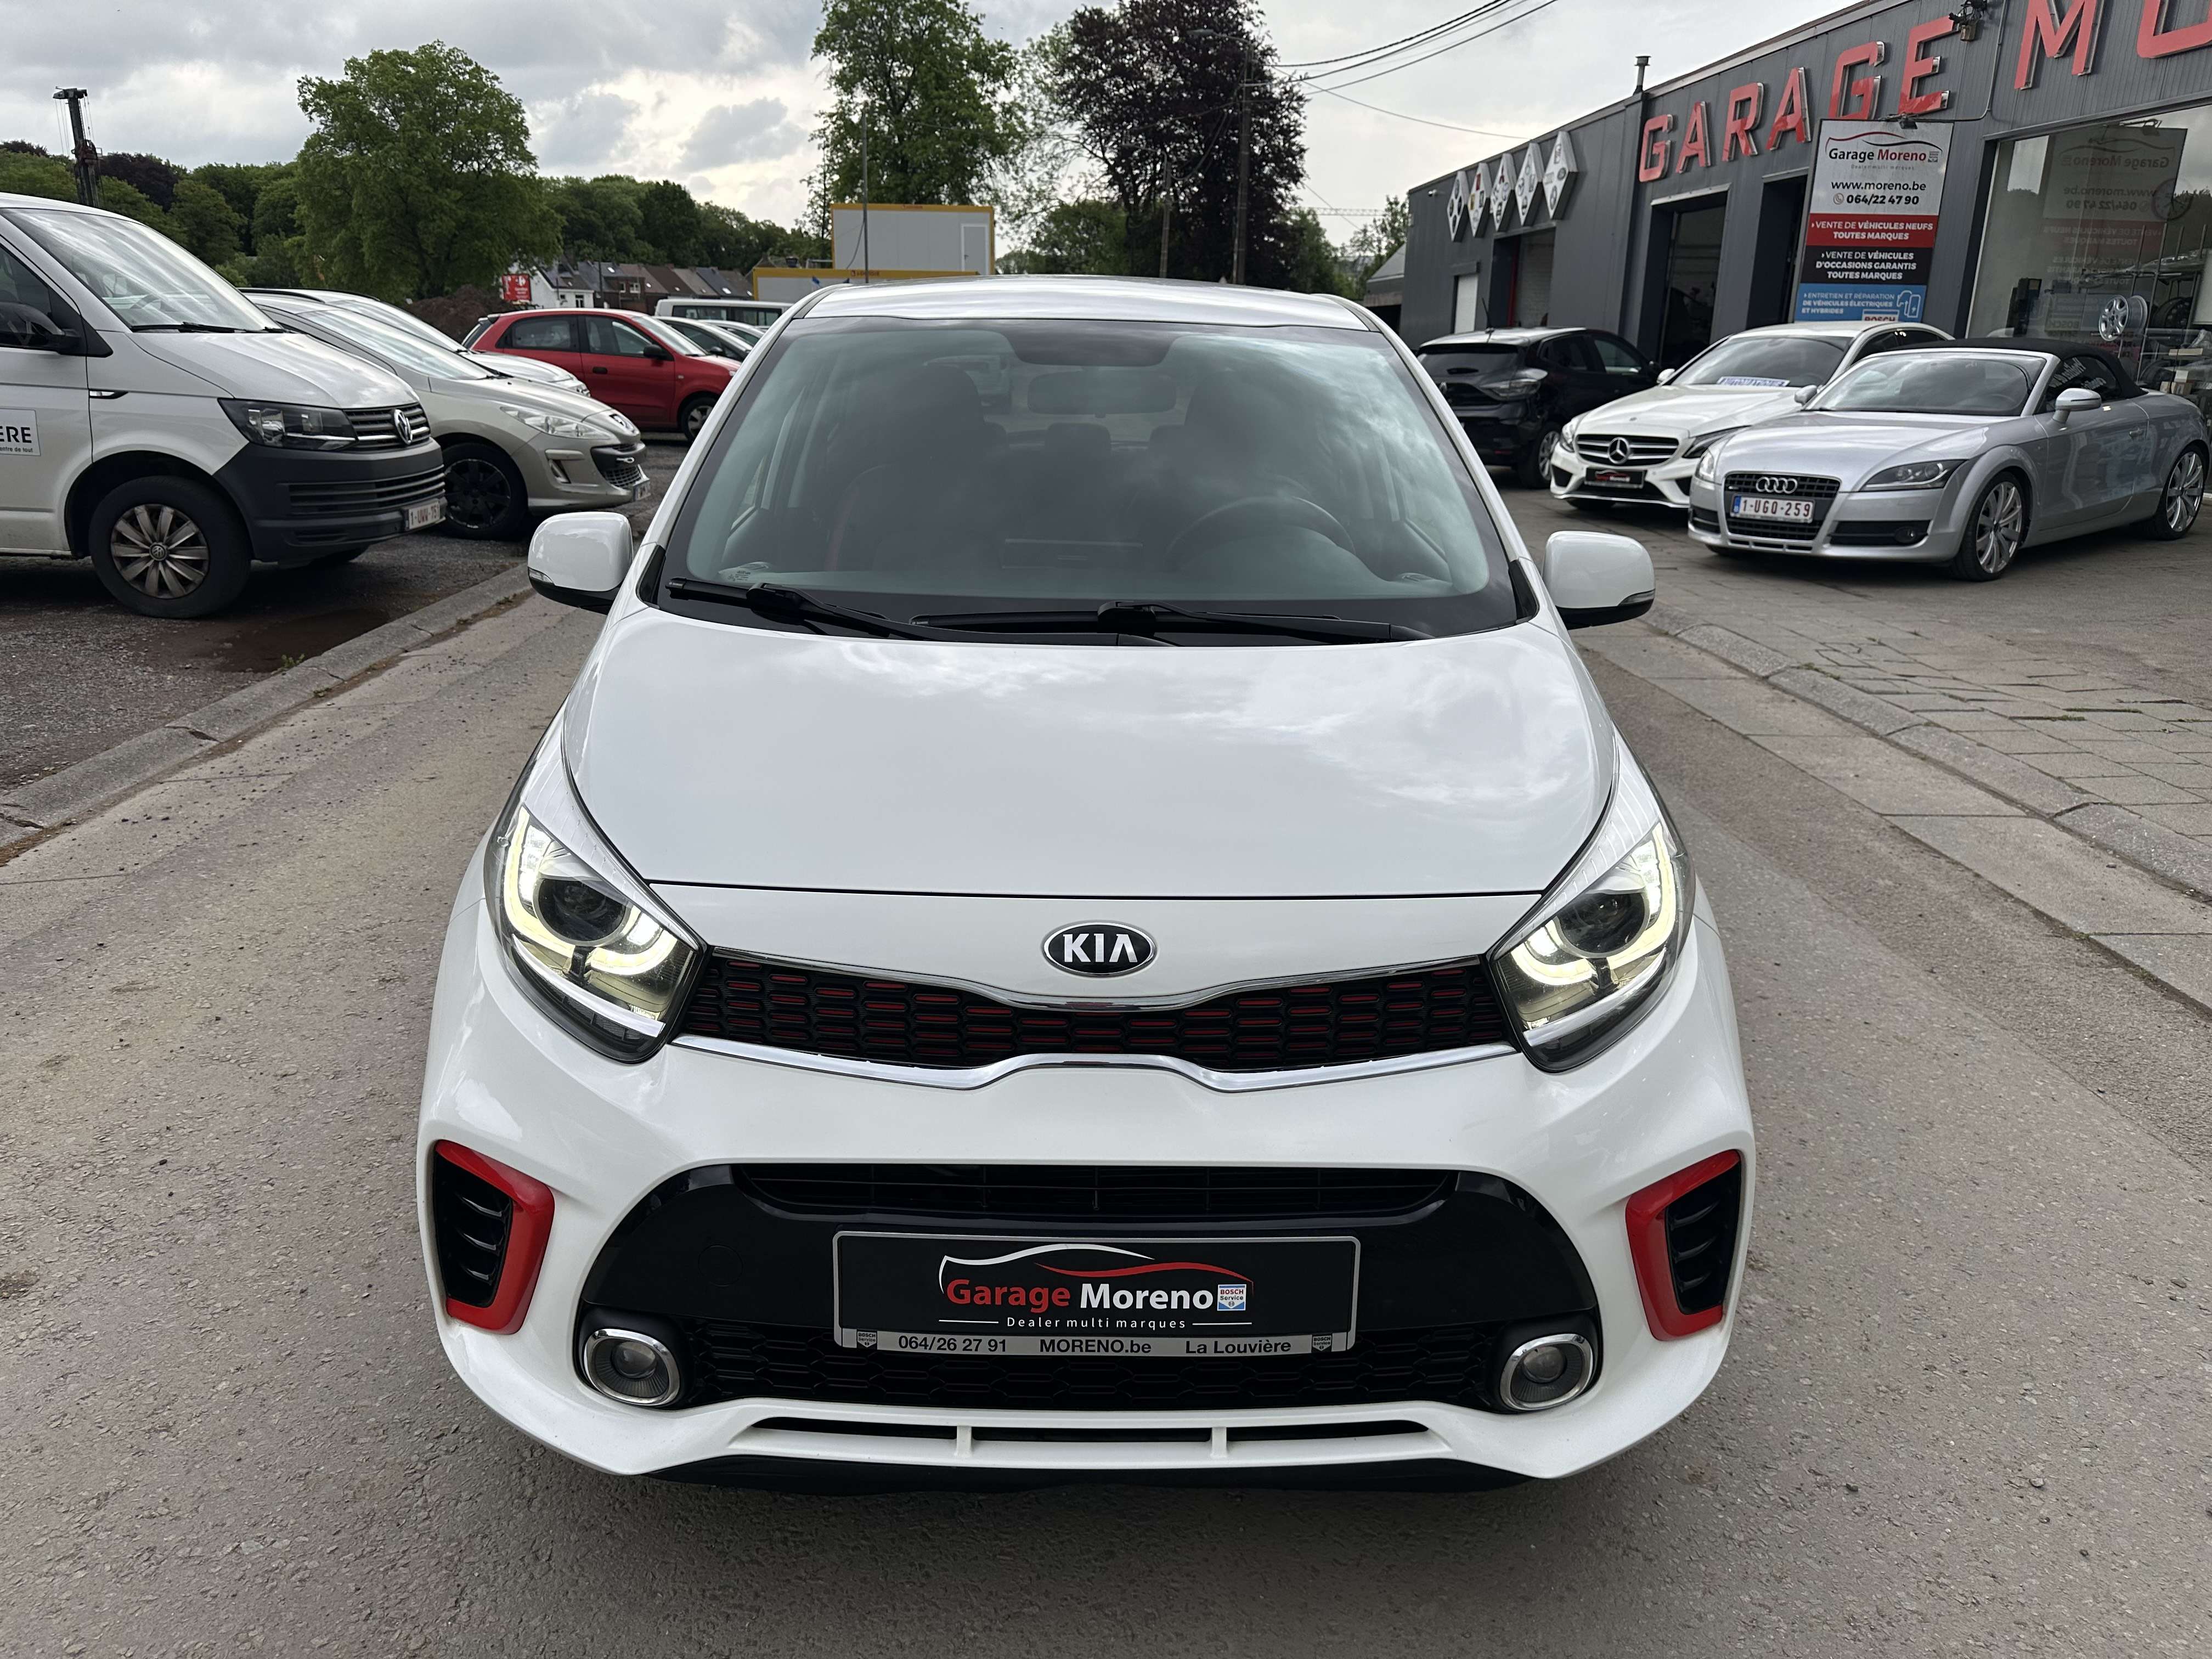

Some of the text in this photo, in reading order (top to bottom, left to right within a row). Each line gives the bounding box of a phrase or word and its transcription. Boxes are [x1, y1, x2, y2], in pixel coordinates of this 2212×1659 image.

[1638, 15, 1960, 183] GARAGE
[1829, 148, 1874, 162] Garage
[1877, 149, 1927, 162] Moreno
[1831, 180, 1926, 191] www.moreno.be
[1847, 194, 1919, 206] 064/22 47 90
[1858, 219, 1904, 230] VÉHICULES
[1867, 232, 1909, 241] MARQUES
[1867, 250, 1914, 259] VÉHICULES
[1861, 272, 1903, 281] MARQUES
[1063, 933, 1138, 963] KIA
[947, 1279, 1214, 1313] Garage Moreno
[1007, 1317, 1186, 1330] Dealer multi marques
[898, 1335, 1291, 1354] 064/26 27 91 MORENO.be La Louvière
